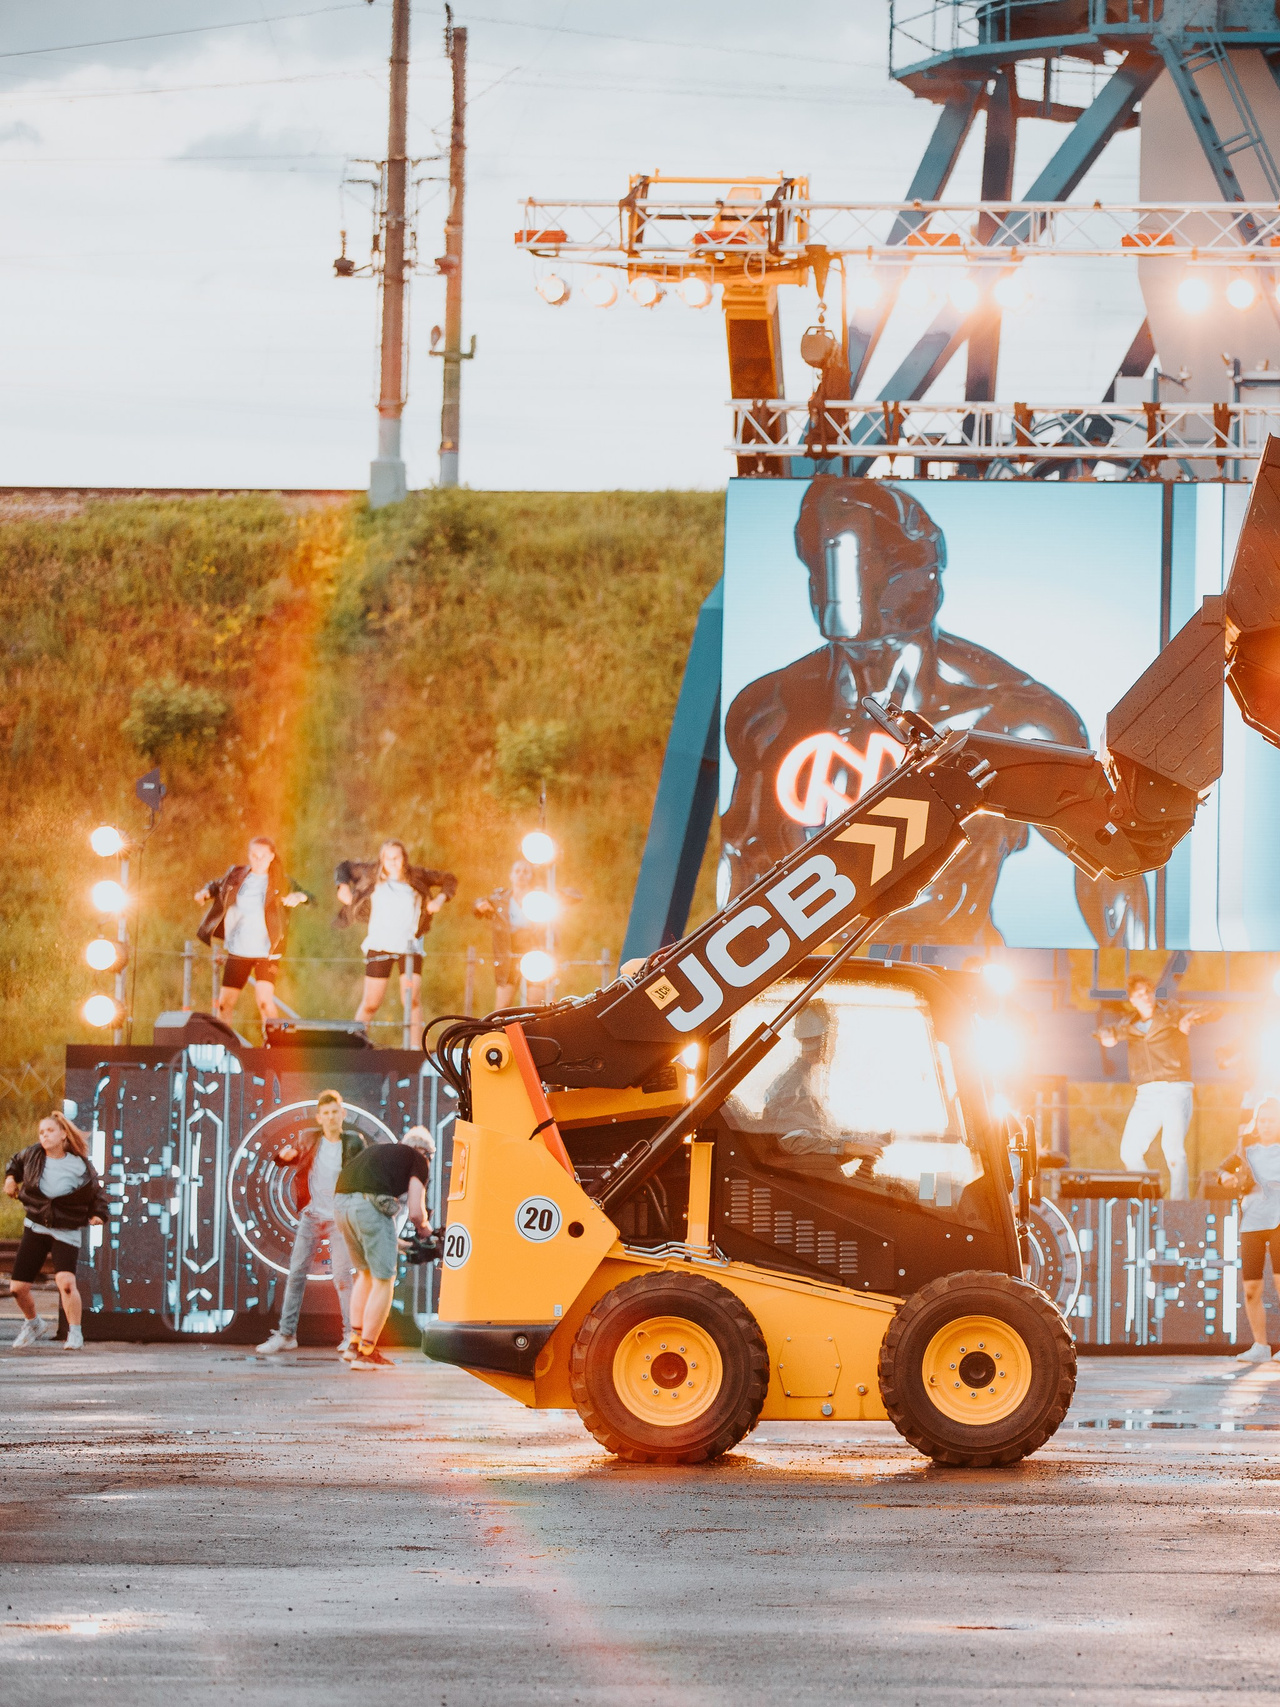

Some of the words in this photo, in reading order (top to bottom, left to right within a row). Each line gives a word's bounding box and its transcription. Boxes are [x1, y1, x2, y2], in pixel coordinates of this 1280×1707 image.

[665, 854, 857, 1033] JCB
[523, 1207, 553, 1232] 20
[446, 1234, 465, 1258] 20
